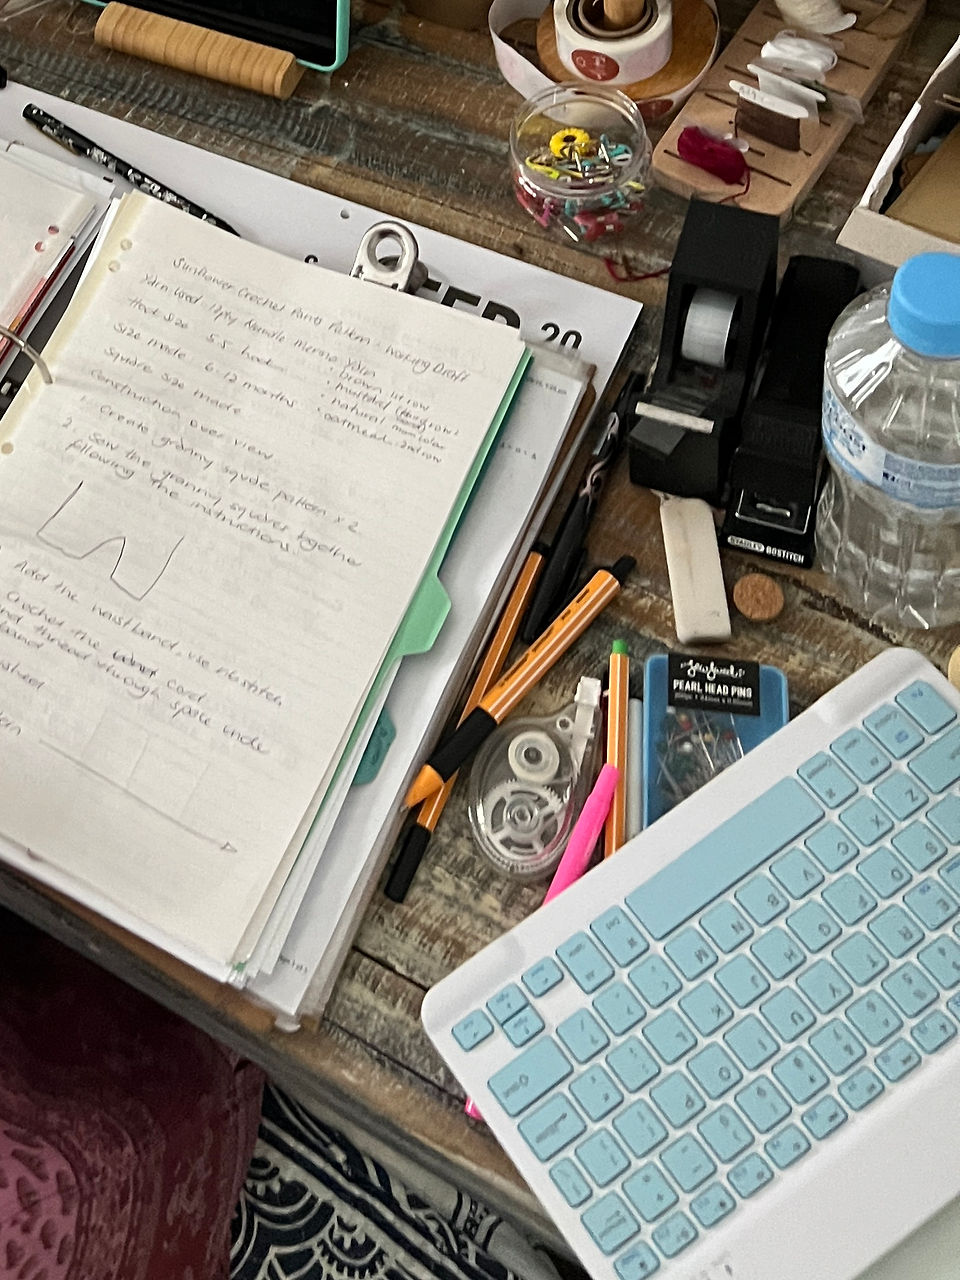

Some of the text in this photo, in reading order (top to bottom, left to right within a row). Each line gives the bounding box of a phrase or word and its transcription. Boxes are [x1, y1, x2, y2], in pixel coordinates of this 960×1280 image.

[172, 257, 233, 290] Sunflower
[237, 287, 286, 312] Crochet
[432, 362, 470, 383] Draft
[64, 439, 136, 480] following
[124, 449, 151, 468] the
[764, 544, 805, 564] BOSTITCH
[13, 560, 50, 582] Add
[55, 581, 77, 601] the
[70, 629, 100, 650] the
[672, 678, 752, 698] PEARL HEAD PINS
